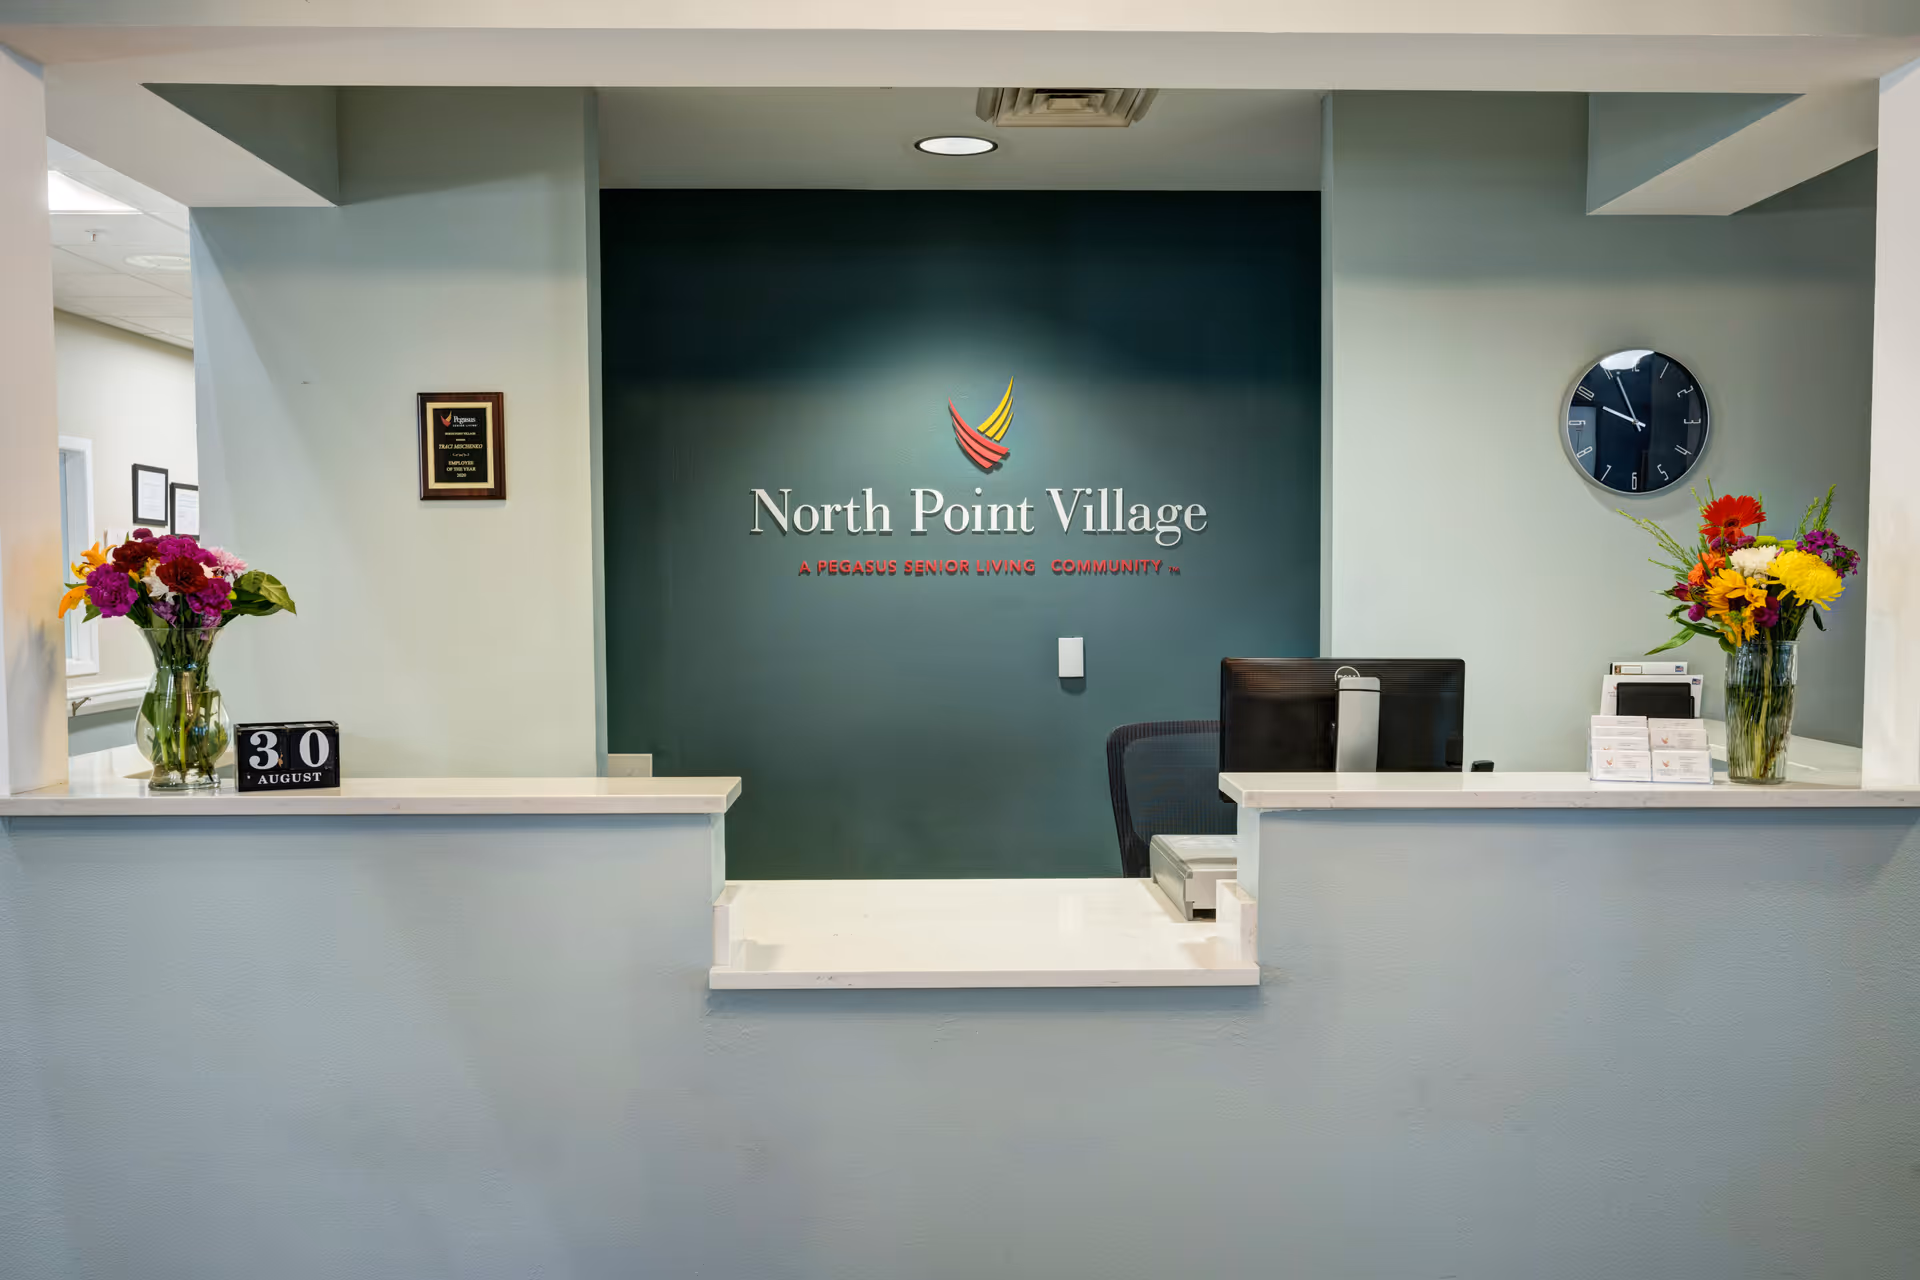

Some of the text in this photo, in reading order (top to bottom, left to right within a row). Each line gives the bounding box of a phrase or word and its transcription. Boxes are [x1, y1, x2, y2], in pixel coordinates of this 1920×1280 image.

[1576, 385, 1595, 401] 10
[454, 416, 476, 424] Pegasus
[1576, 446, 1593, 458] 8
[1631, 472, 1638, 490] 6
[750, 487, 1207, 547] North Point Village
[799, 560, 811, 574] A
[817, 560, 897, 573] PEGASUS
[904, 560, 969, 573] SENIOR
[976, 559, 1035, 573] LIVING
[1051, 559, 1163, 573] COMMUNITY
[257, 772, 322, 785] AUGUST
